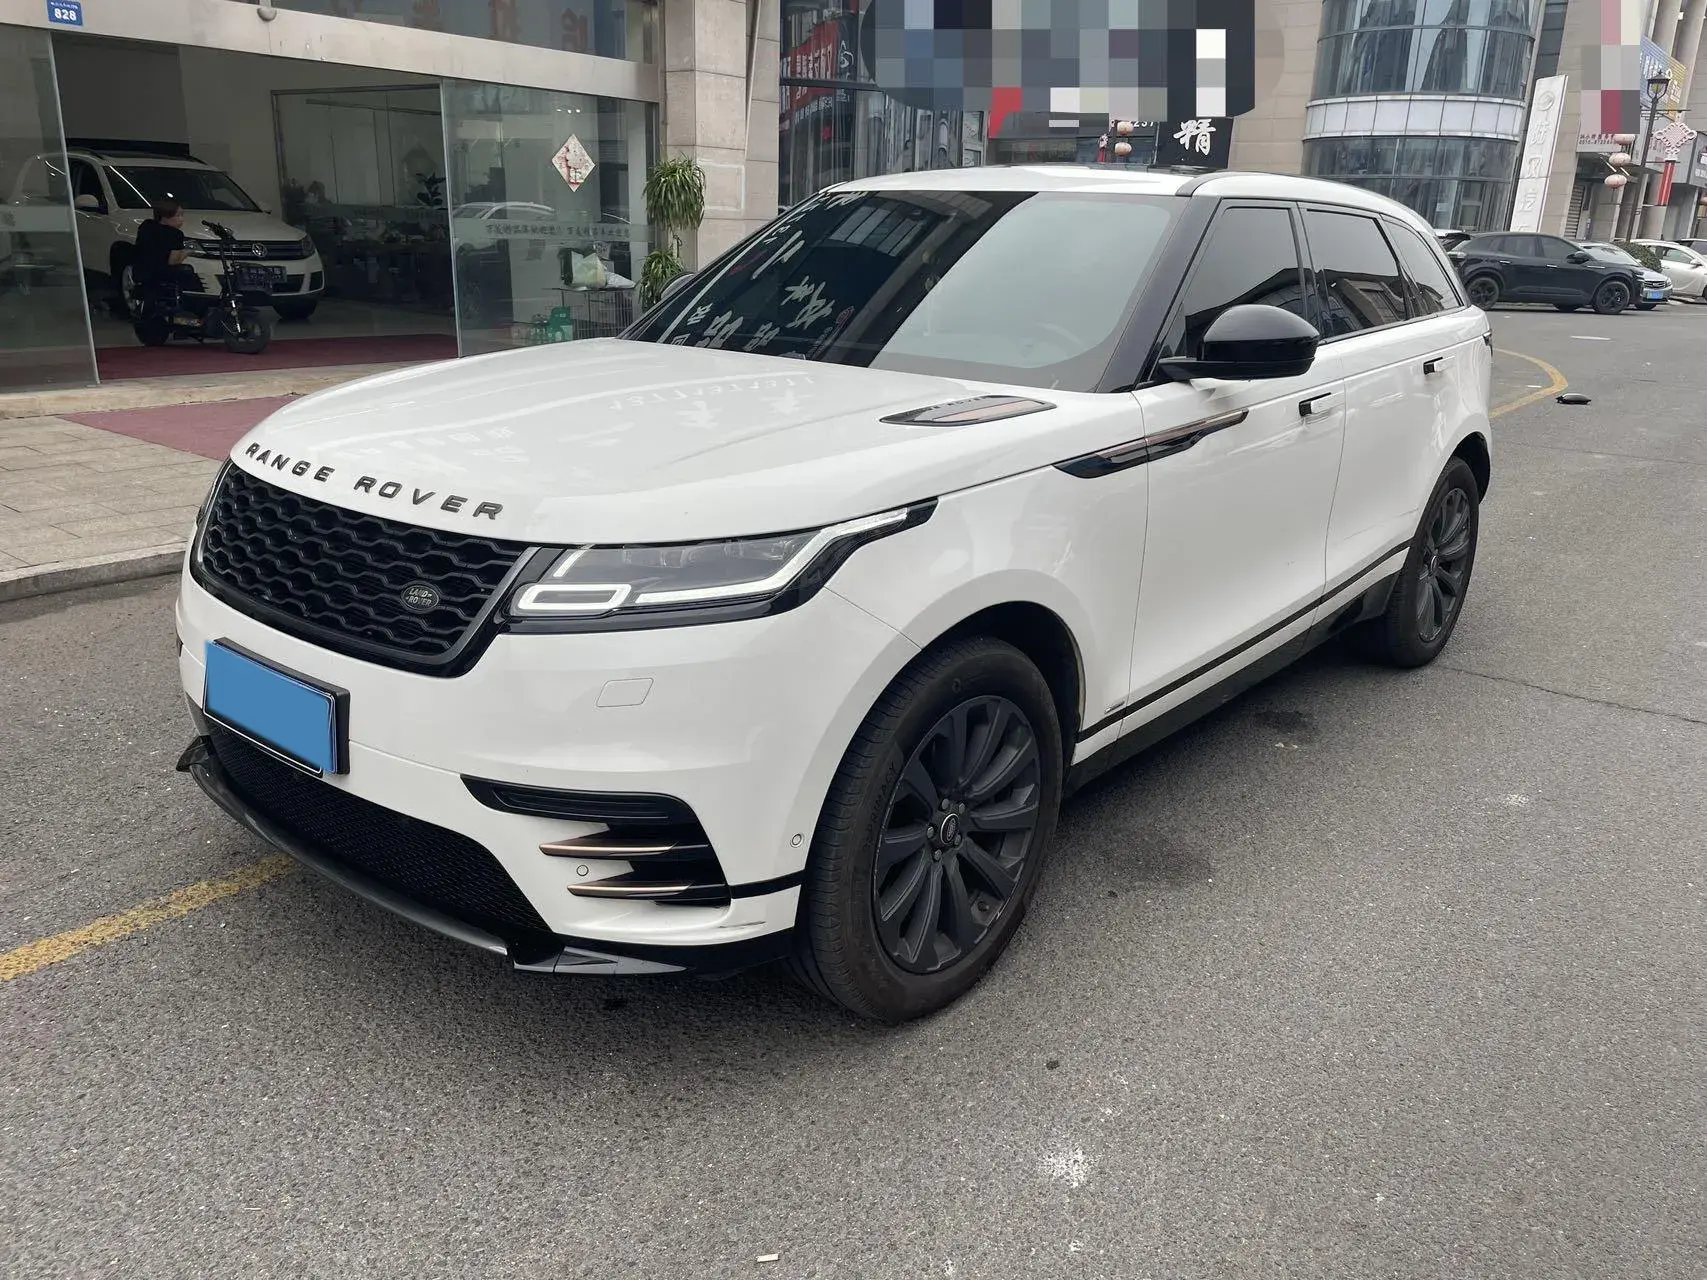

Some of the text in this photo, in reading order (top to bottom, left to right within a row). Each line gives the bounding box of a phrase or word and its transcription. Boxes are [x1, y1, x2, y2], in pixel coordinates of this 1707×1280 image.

[54, 8, 77, 21] 828
[1173, 118, 1217, 156] 精
[245, 442, 504, 520] RANGE ROVER
